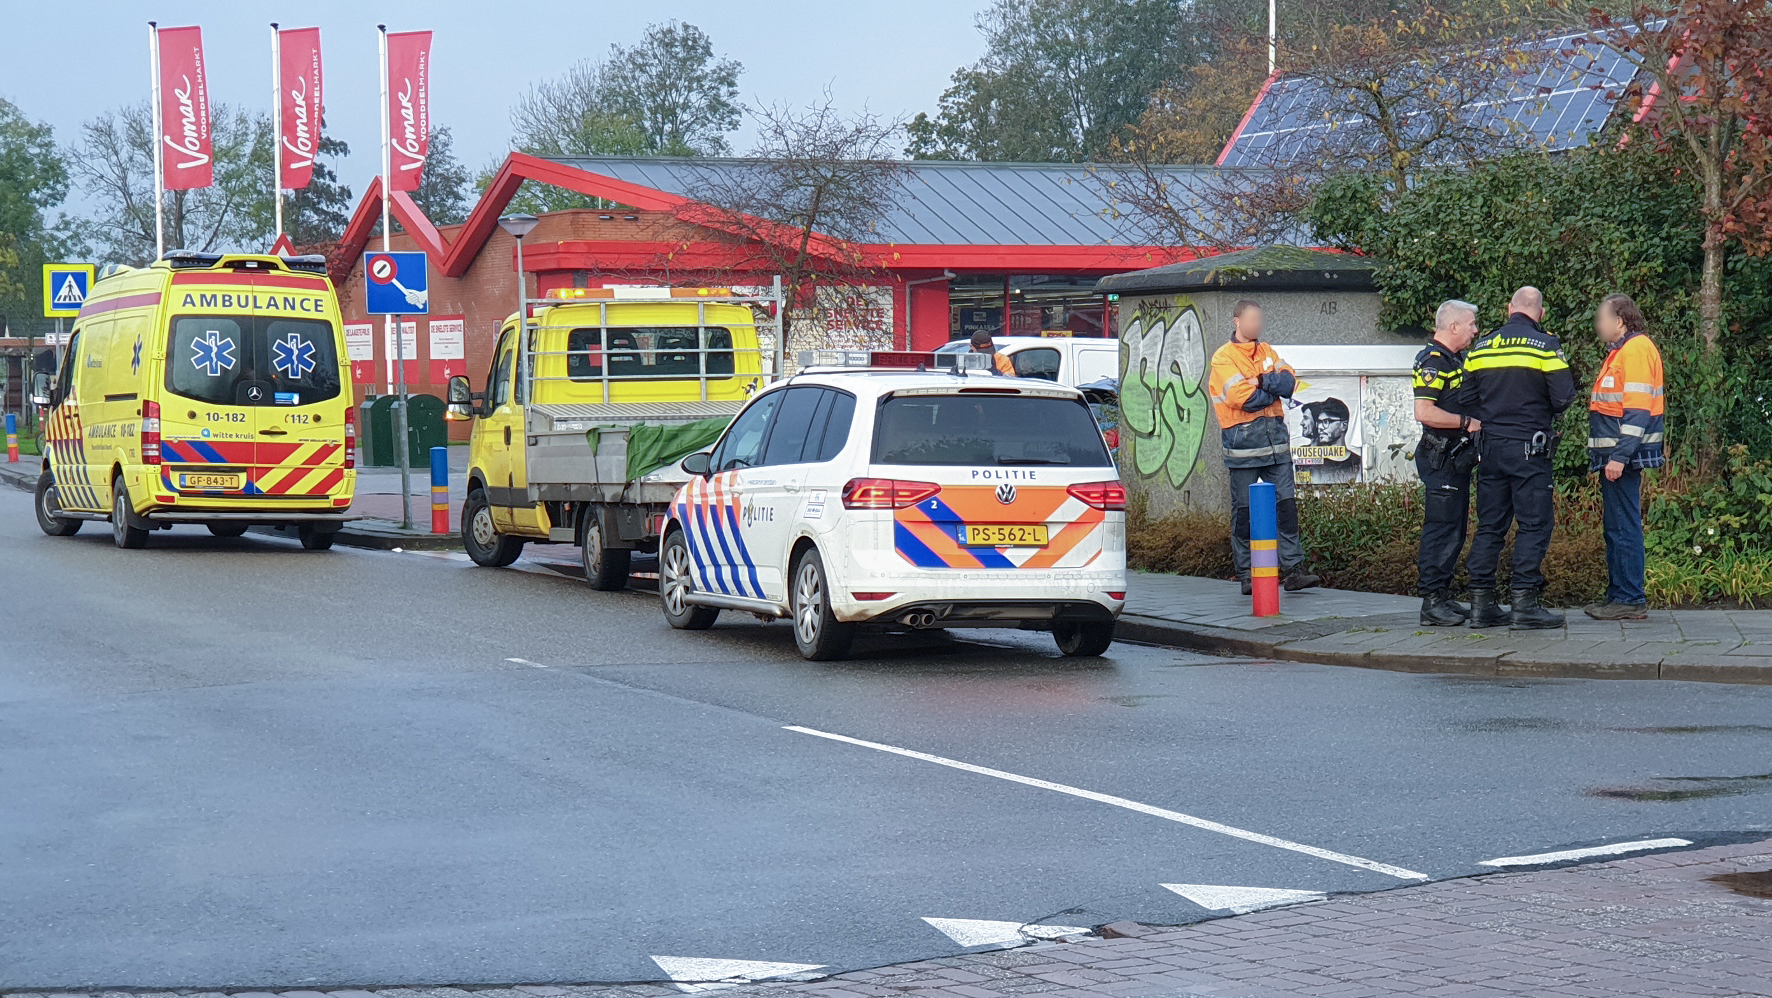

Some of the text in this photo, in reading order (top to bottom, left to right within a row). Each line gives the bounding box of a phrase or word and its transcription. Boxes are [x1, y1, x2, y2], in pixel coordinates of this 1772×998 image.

[193, 46, 207, 139] VOORDEELMARKT
[164, 74, 209, 168] Vomar
[283, 76, 314, 168] Vomar
[391, 77, 426, 171] Vomar
[182, 293, 324, 313] AMBULANCE
[1320, 301, 1337, 315] AB
[205, 412, 246, 423] 10-182
[235, 432, 254, 440] kruis
[1291, 446, 1344, 458] HOUSEQUAKE
[190, 476, 234, 486] GF-843-T
[972, 469, 1037, 480] POLITIE
[930, 500, 938, 509] 2
[972, 527, 1042, 542] PS-562-L
